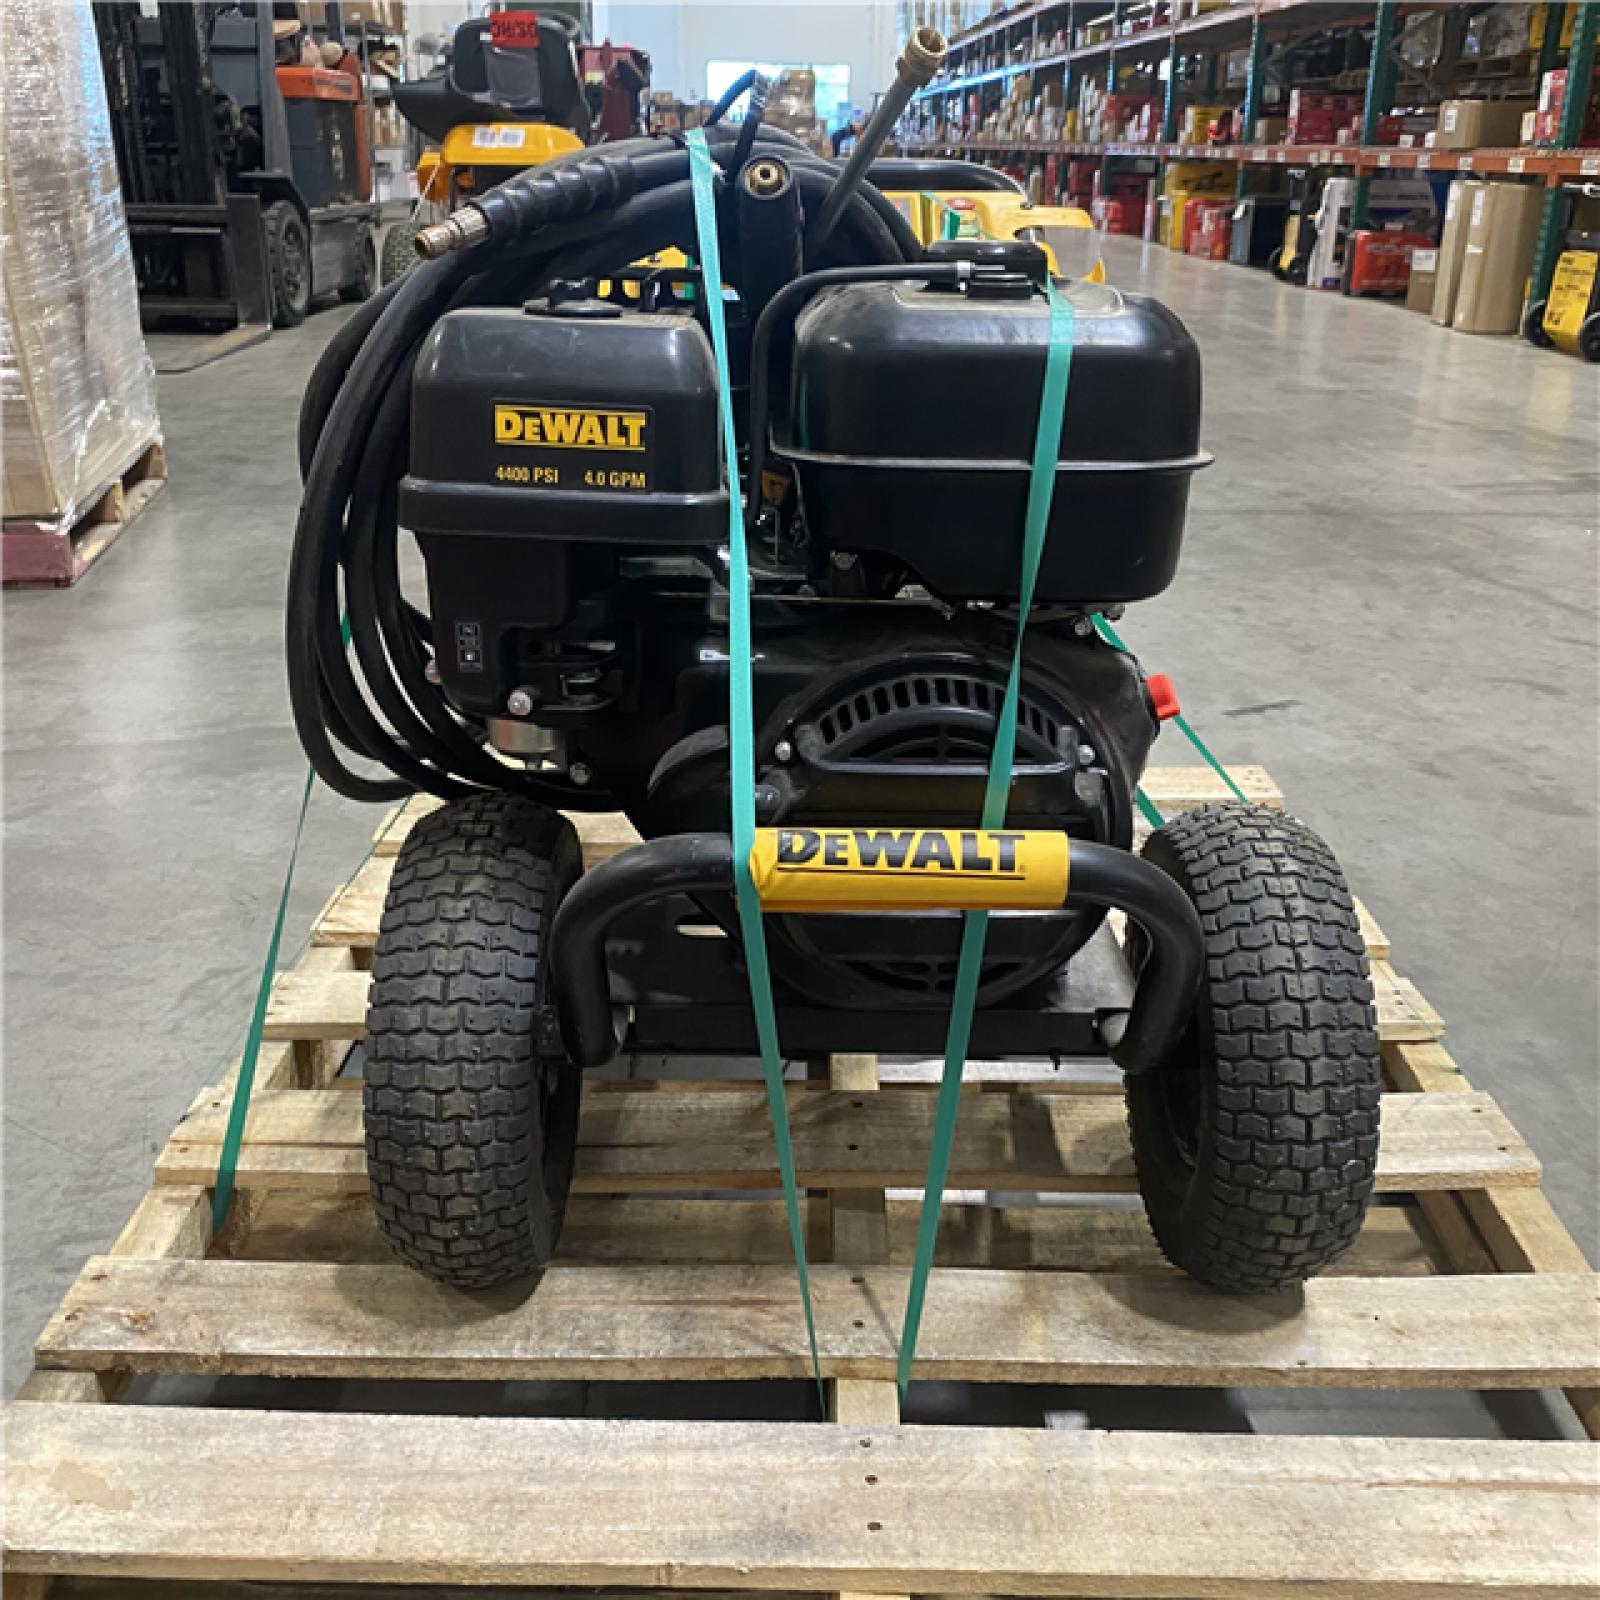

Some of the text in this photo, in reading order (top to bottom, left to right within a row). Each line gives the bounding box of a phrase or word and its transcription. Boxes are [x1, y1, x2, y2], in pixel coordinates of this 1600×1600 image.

[496, 410, 646, 447] DEWALT
[496, 465, 558, 483] 4400 PSI
[585, 470, 646, 488] 4.0 GPM
[777, 830, 1026, 872] DEWALT
